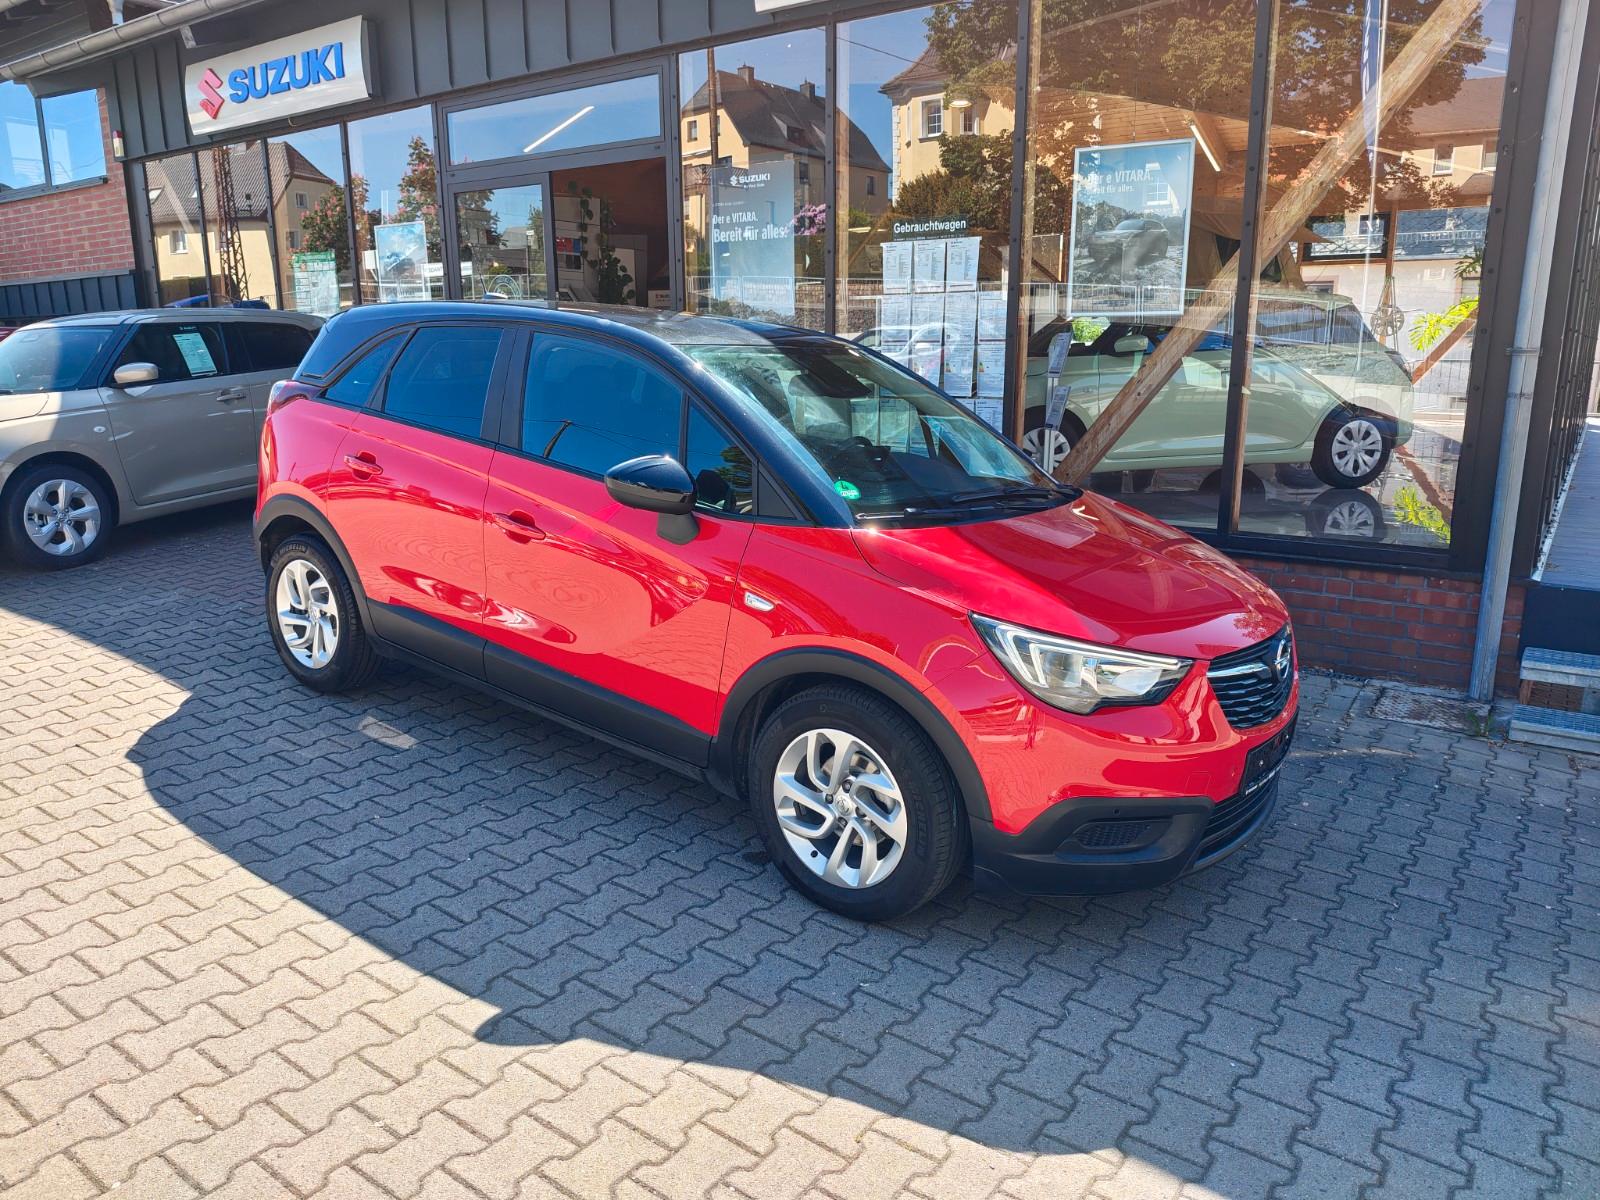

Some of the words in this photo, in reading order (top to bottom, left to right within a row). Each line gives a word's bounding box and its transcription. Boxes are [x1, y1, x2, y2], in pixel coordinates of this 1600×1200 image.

[228, 41, 346, 104] SUZUKI
[738, 174, 770, 183] SUZUKI
[1115, 169, 1153, 183] VITARA.
[713, 214, 725, 225] Der
[726, 215, 730, 223] e
[732, 211, 759, 224] VITARA.
[893, 220, 966, 234] Gebrauchtwagen
[713, 227, 742, 243] Bereit
